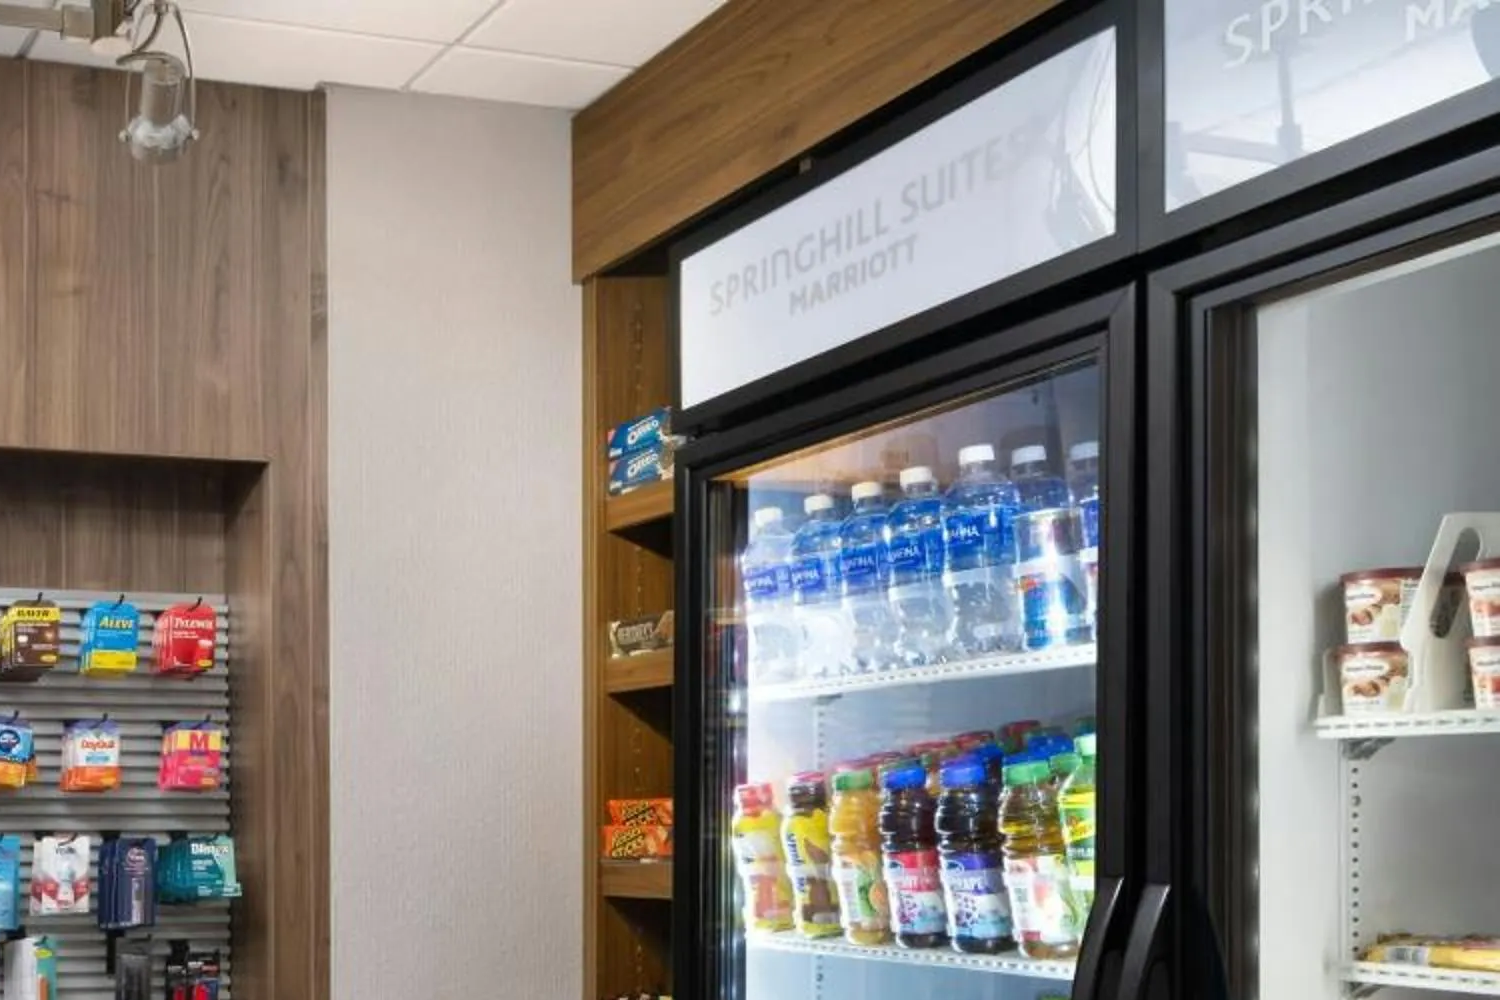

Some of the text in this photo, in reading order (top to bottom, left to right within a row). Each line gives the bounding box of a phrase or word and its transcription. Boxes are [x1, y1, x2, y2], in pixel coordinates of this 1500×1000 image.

[709, 122, 1030, 318] SPRINGHILL SUITES
[788, 233, 920, 317] MARRIOTT
